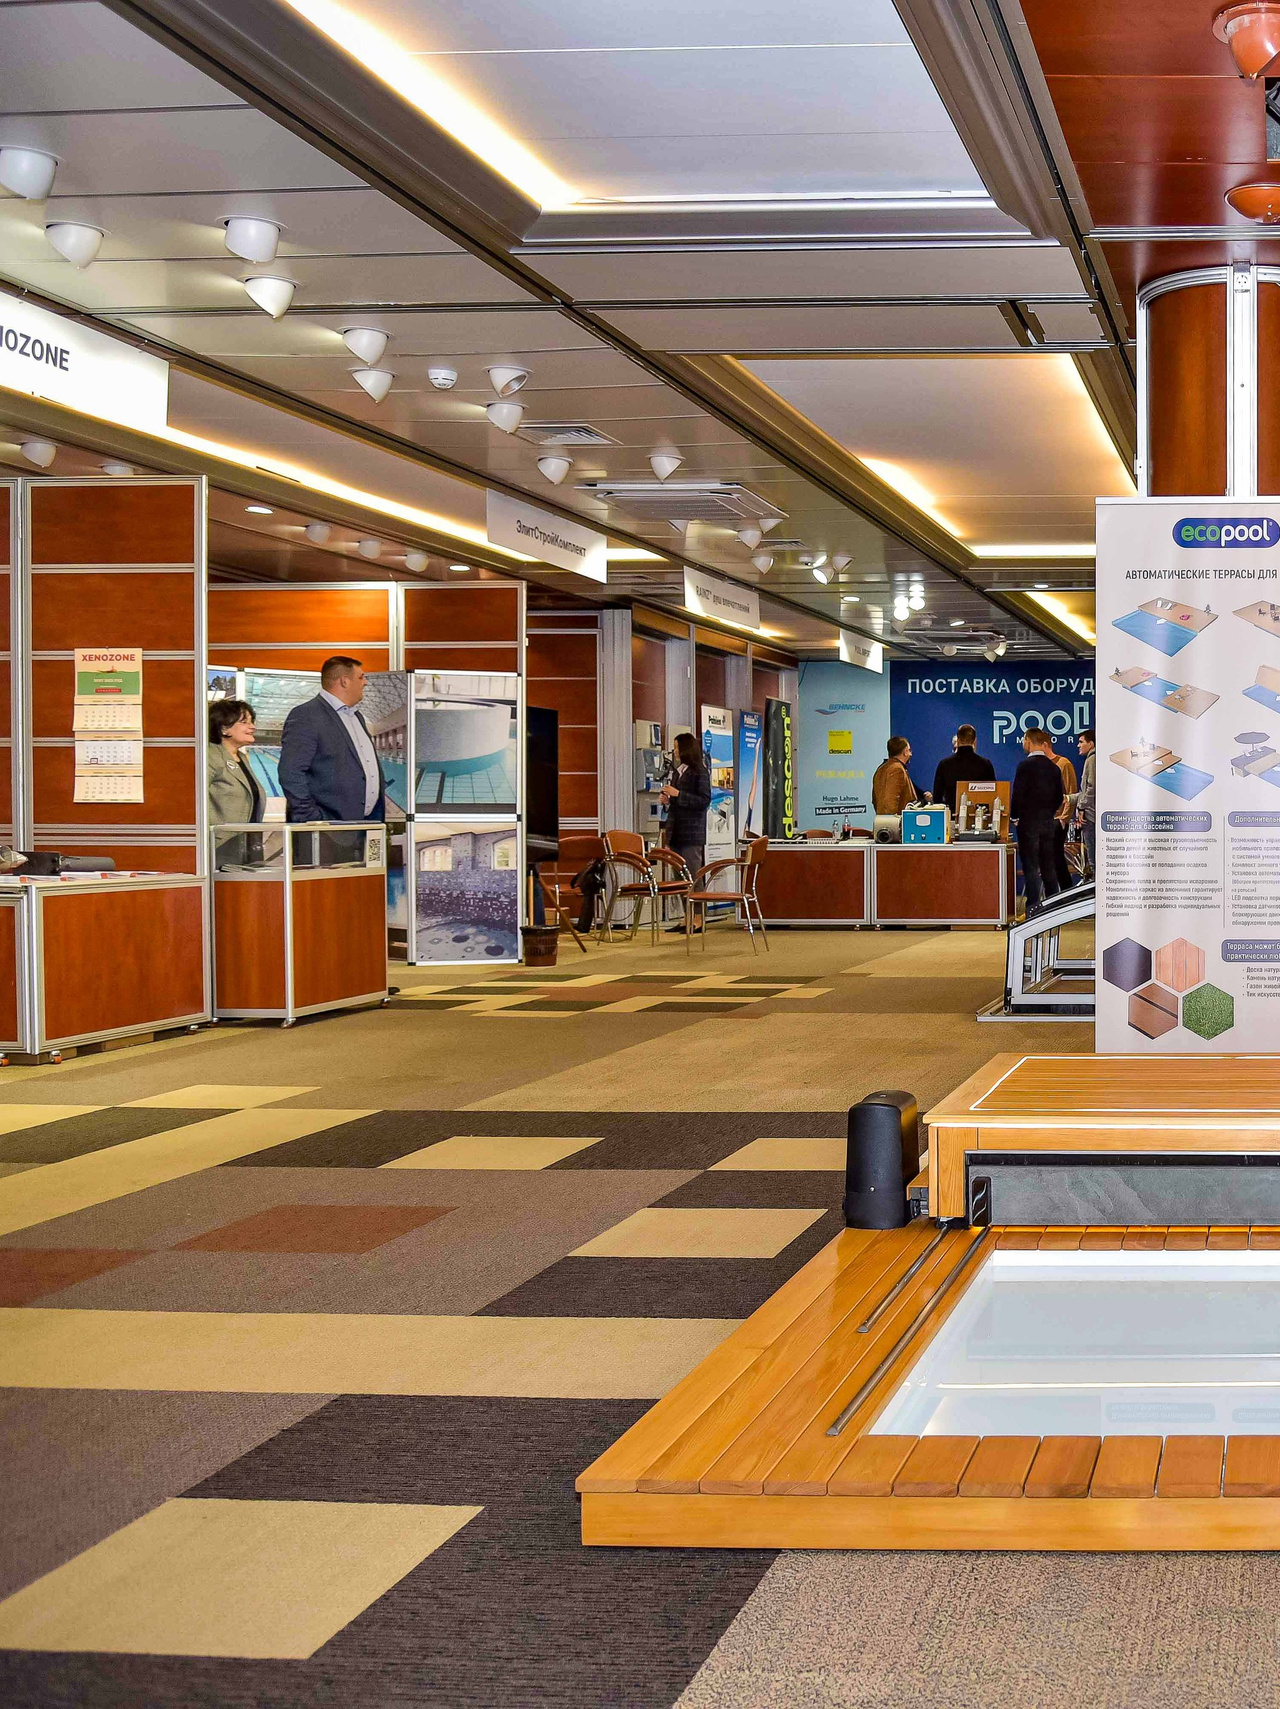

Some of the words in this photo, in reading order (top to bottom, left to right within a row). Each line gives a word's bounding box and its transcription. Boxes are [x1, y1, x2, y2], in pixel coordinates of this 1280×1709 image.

[516, 519, 587, 557] ЭлитСтройКомплект
[1181, 519, 1270, 547] ecopool
[1125, 569, 1210, 580] АВТОМАТИЧЕСКИЕ
[1213, 569, 1255, 580] ТЕРРАСЫ
[1258, 569, 1278, 580] ДЛЯ
[82, 654, 136, 662] XENOZONE
[907, 678, 1010, 694] ПОСТАВКА
[1016, 678, 1095, 696] ОБОРУД
[822, 795, 838, 803] Hugo
[840, 806, 866, 814] Germany
